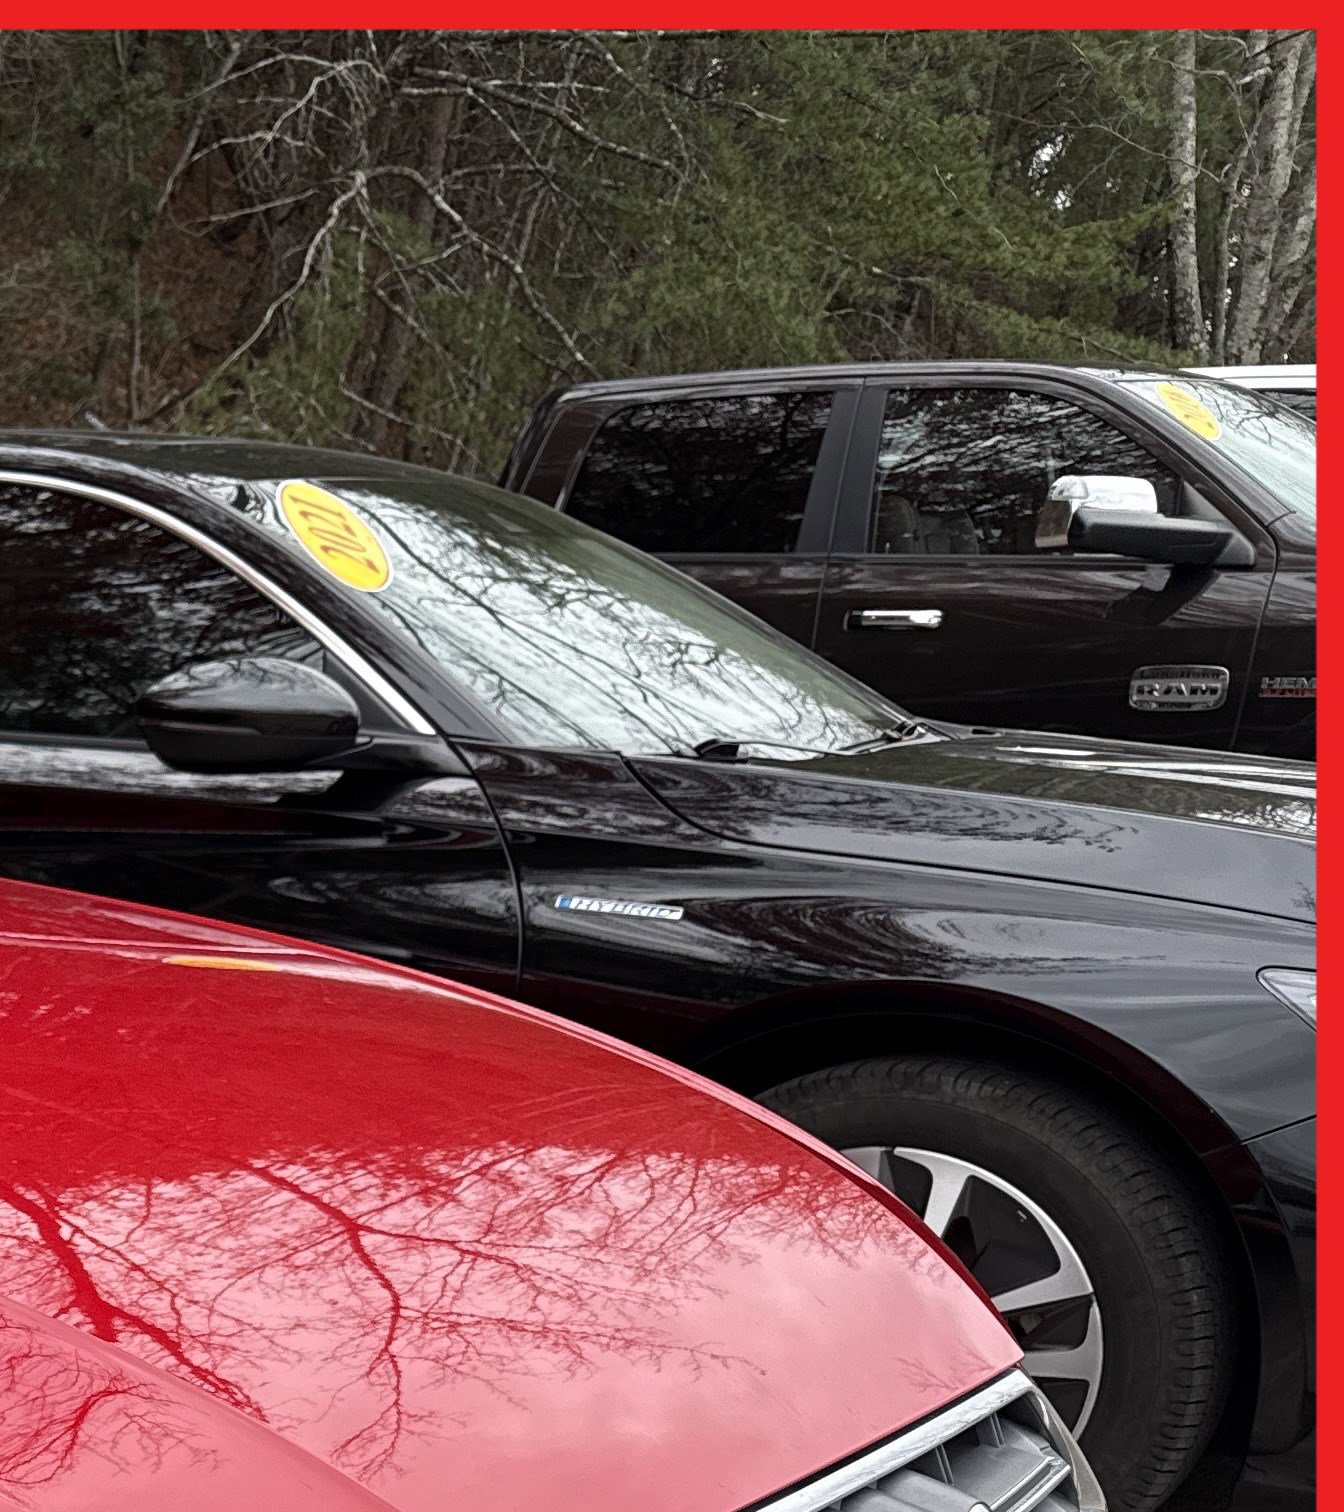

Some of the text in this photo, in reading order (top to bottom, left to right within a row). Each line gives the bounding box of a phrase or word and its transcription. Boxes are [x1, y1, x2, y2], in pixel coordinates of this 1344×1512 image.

[288, 494, 380, 574] 2021
[1134, 682, 1223, 699] RAM
[569, 896, 683, 920] HYBRID
